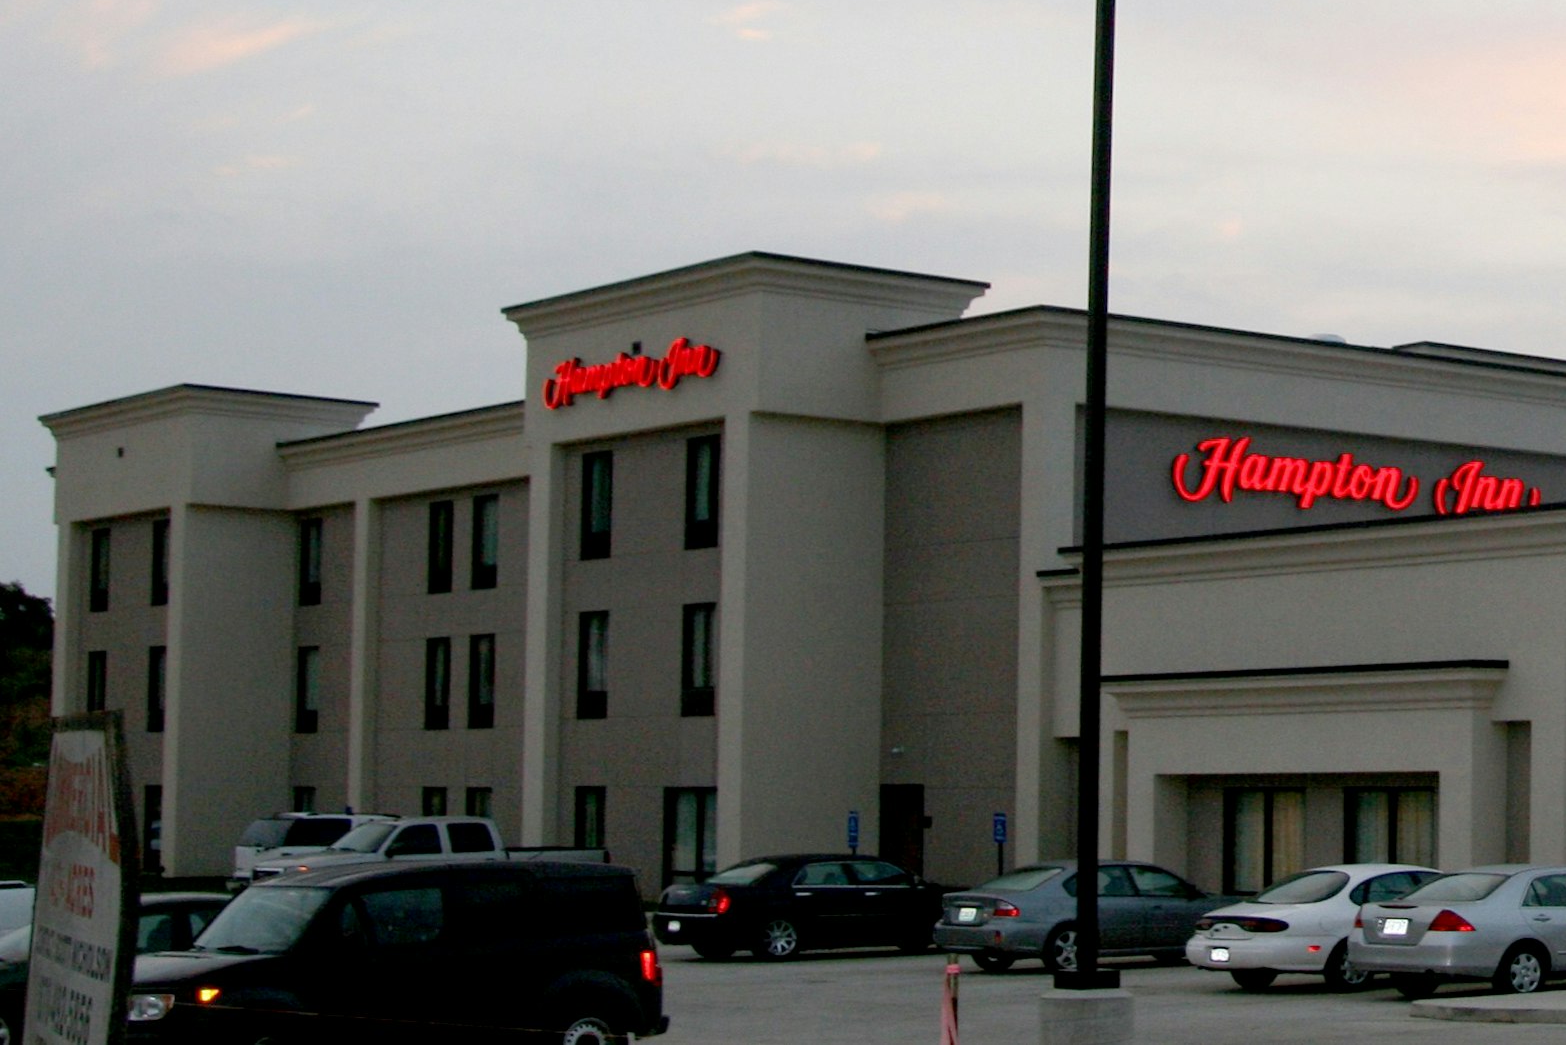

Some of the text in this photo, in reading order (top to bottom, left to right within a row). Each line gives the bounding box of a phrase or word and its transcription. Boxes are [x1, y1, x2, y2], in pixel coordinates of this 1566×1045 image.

[543, 337, 720, 409] Hampton Inn
[1172, 436, 1541, 515] Hampton Inn
